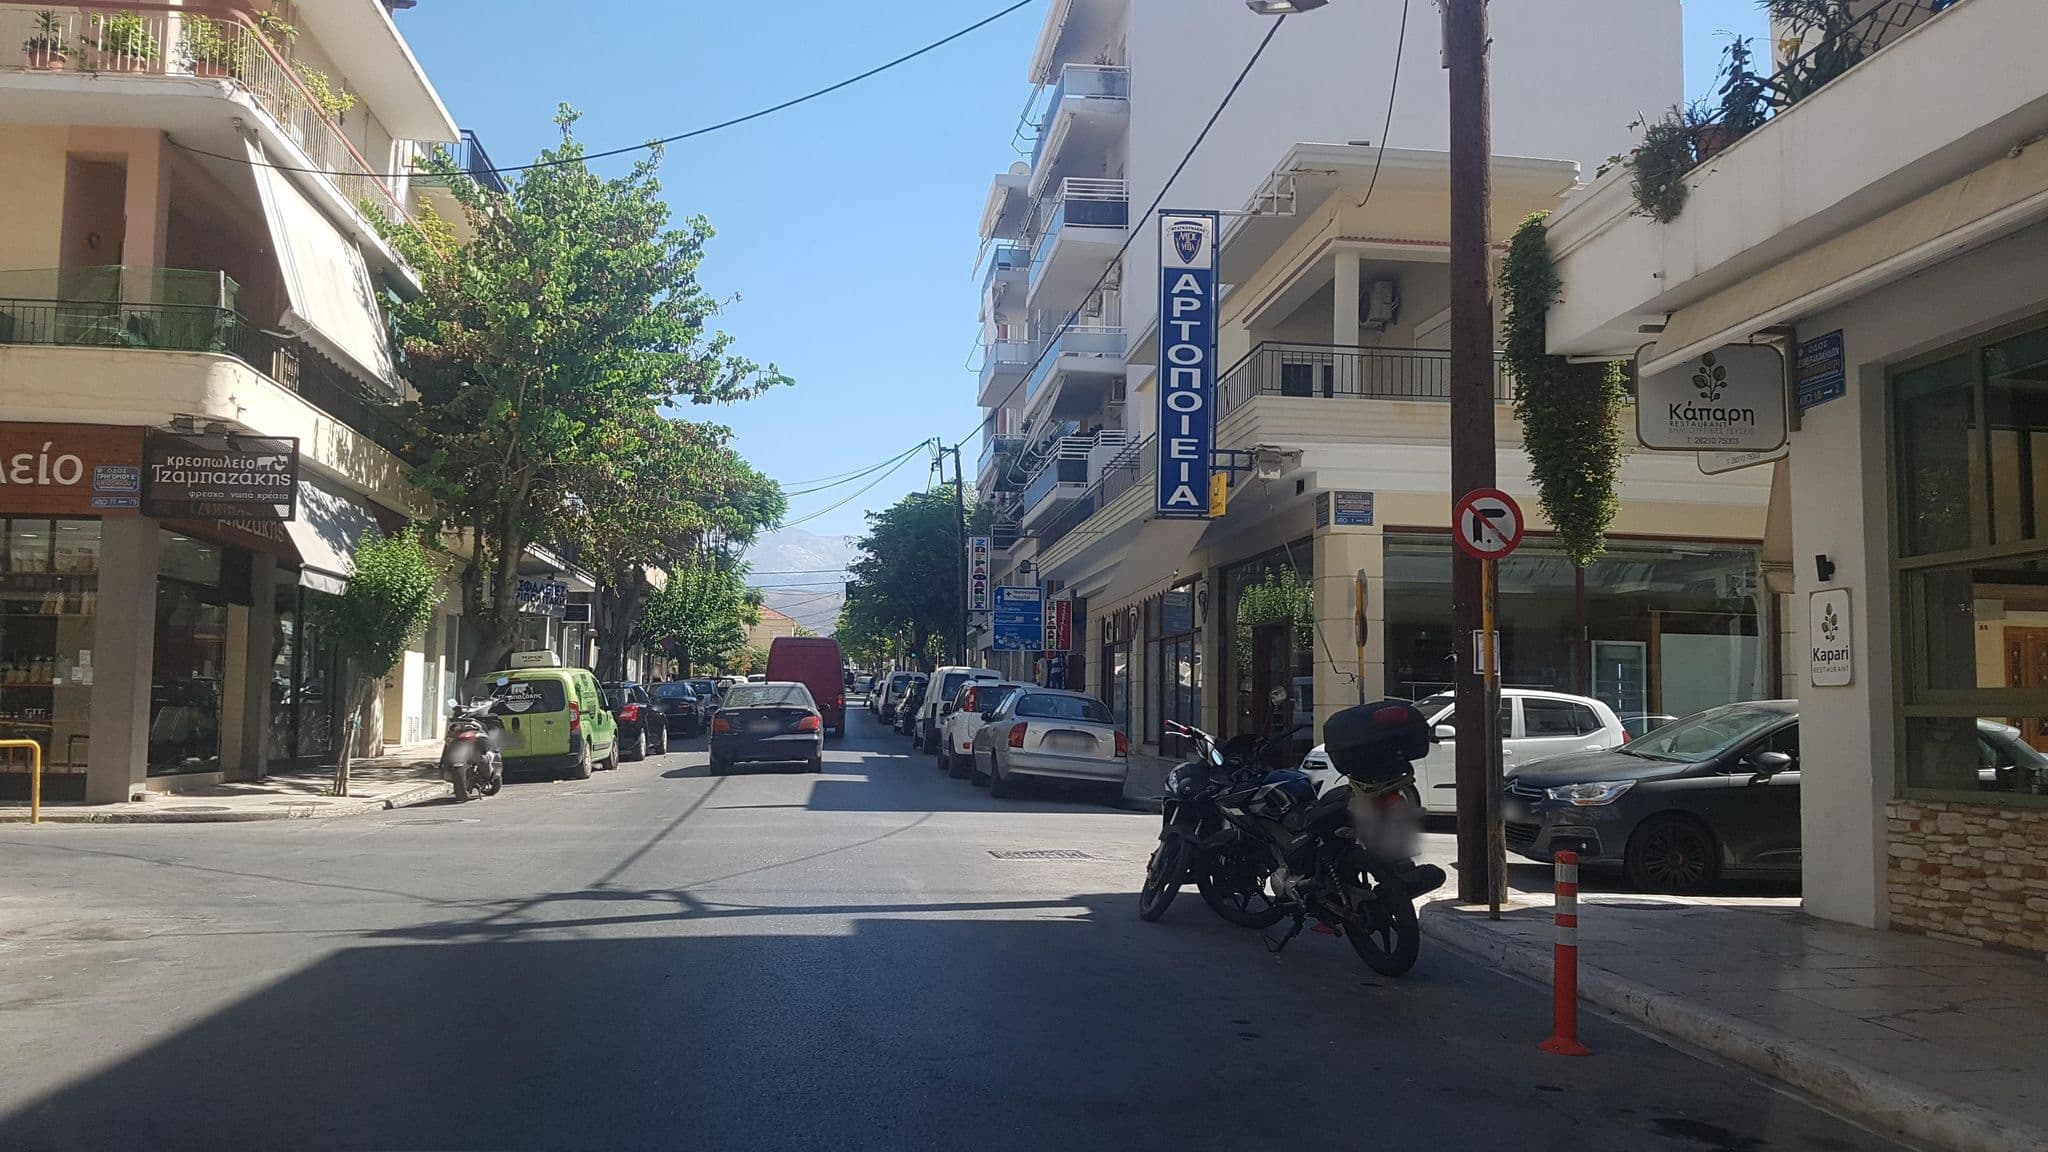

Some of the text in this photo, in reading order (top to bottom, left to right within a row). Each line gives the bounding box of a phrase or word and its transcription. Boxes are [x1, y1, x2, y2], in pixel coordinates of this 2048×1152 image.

[1166, 273, 1204, 506] ΑΡΤΟΠΟΙΕΙΑ
[1669, 401, 1755, 426] Κάπαρη
[0, 441, 84, 486] είο
[167, 455, 255, 470] κρεοπωλείο
[1813, 645, 1849, 665] Kapari
[1813, 665, 1849, 673] RESTAURANT
